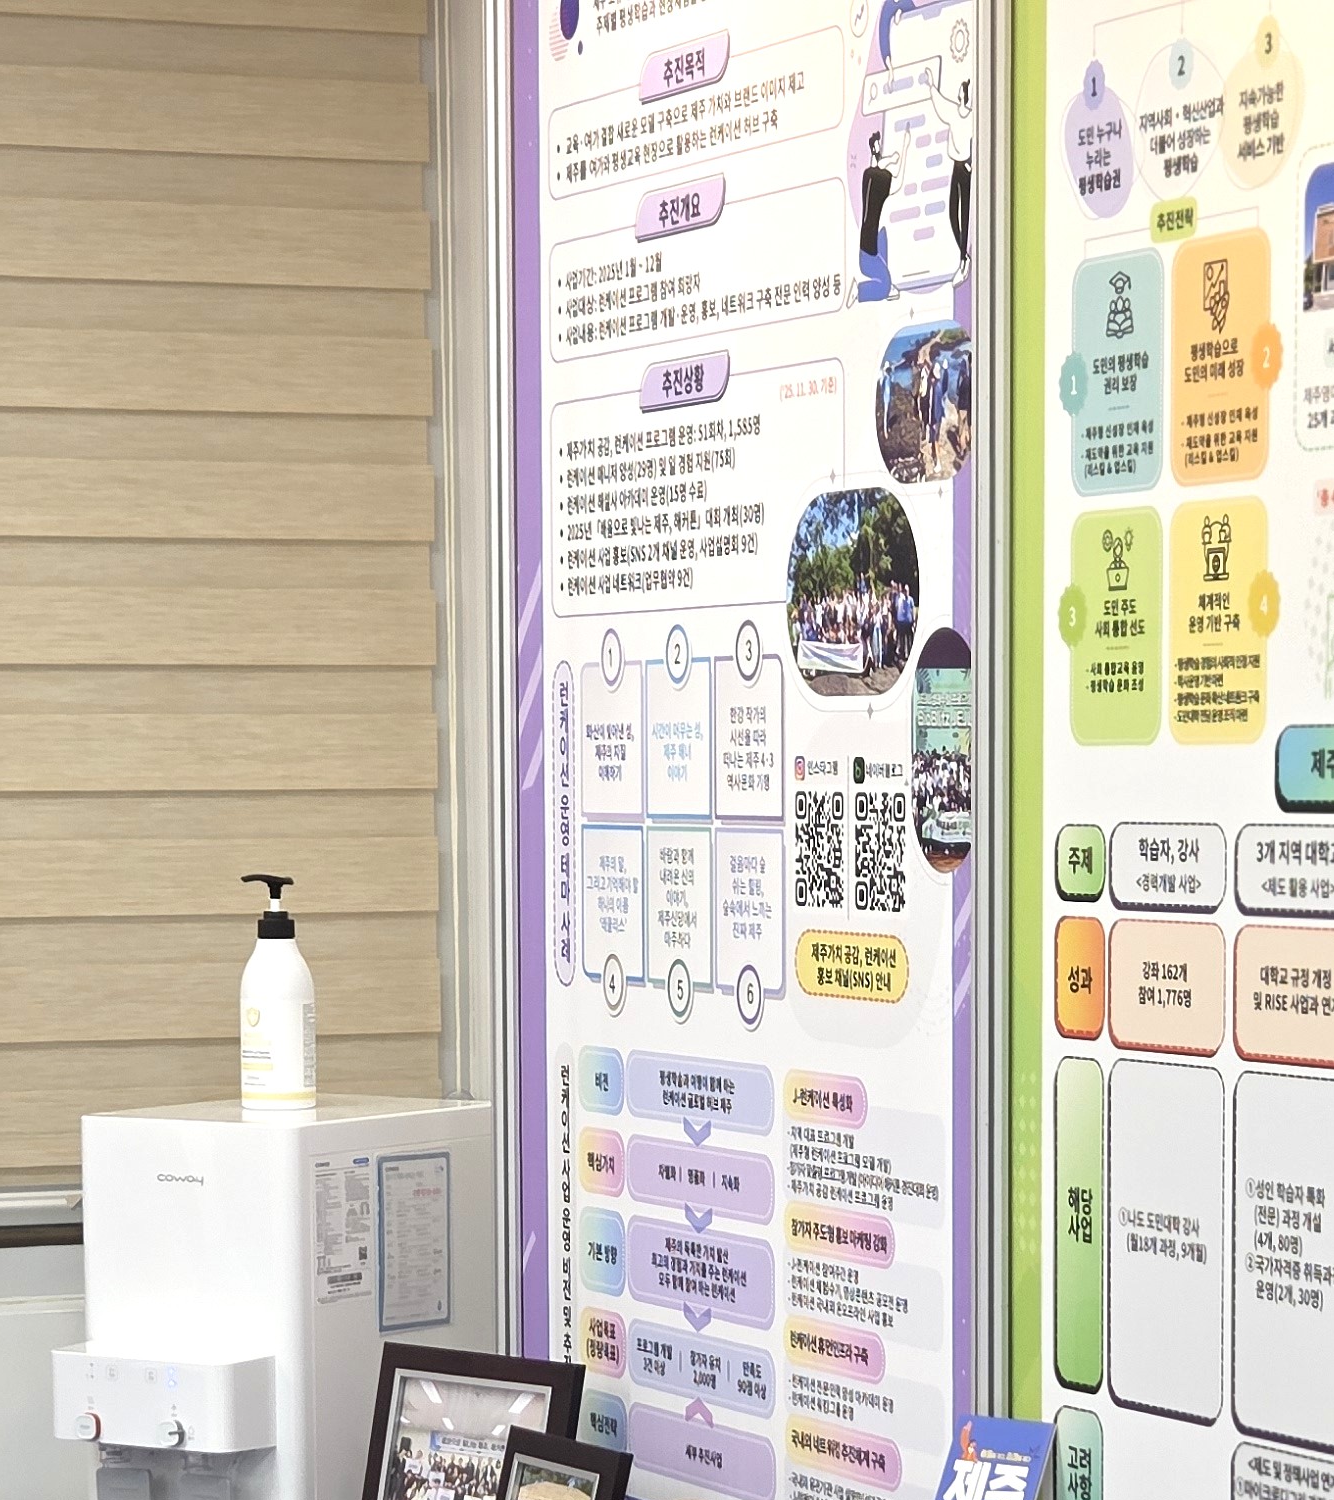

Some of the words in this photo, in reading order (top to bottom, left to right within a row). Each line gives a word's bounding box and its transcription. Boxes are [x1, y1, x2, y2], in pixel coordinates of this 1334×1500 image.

[662, 47, 705, 89] 추진목적
[658, 192, 701, 229] 추진개요
[661, 363, 705, 399] 추진상황
[1068, 846, 1093, 875] 주제
[1138, 837, 1175, 866] 학습자,
[1177, 837, 1200, 864] 강사
[1256, 839, 1276, 865] 3개
[1278, 839, 1302, 866] 지역
[1067, 965, 1094, 995] 성과
[1142, 960, 1160, 982] 강좌
[1161, 962, 1188, 983] 162개
[156, 1173, 205, 1187] coway
[1067, 1445, 1092, 1473] 고려
